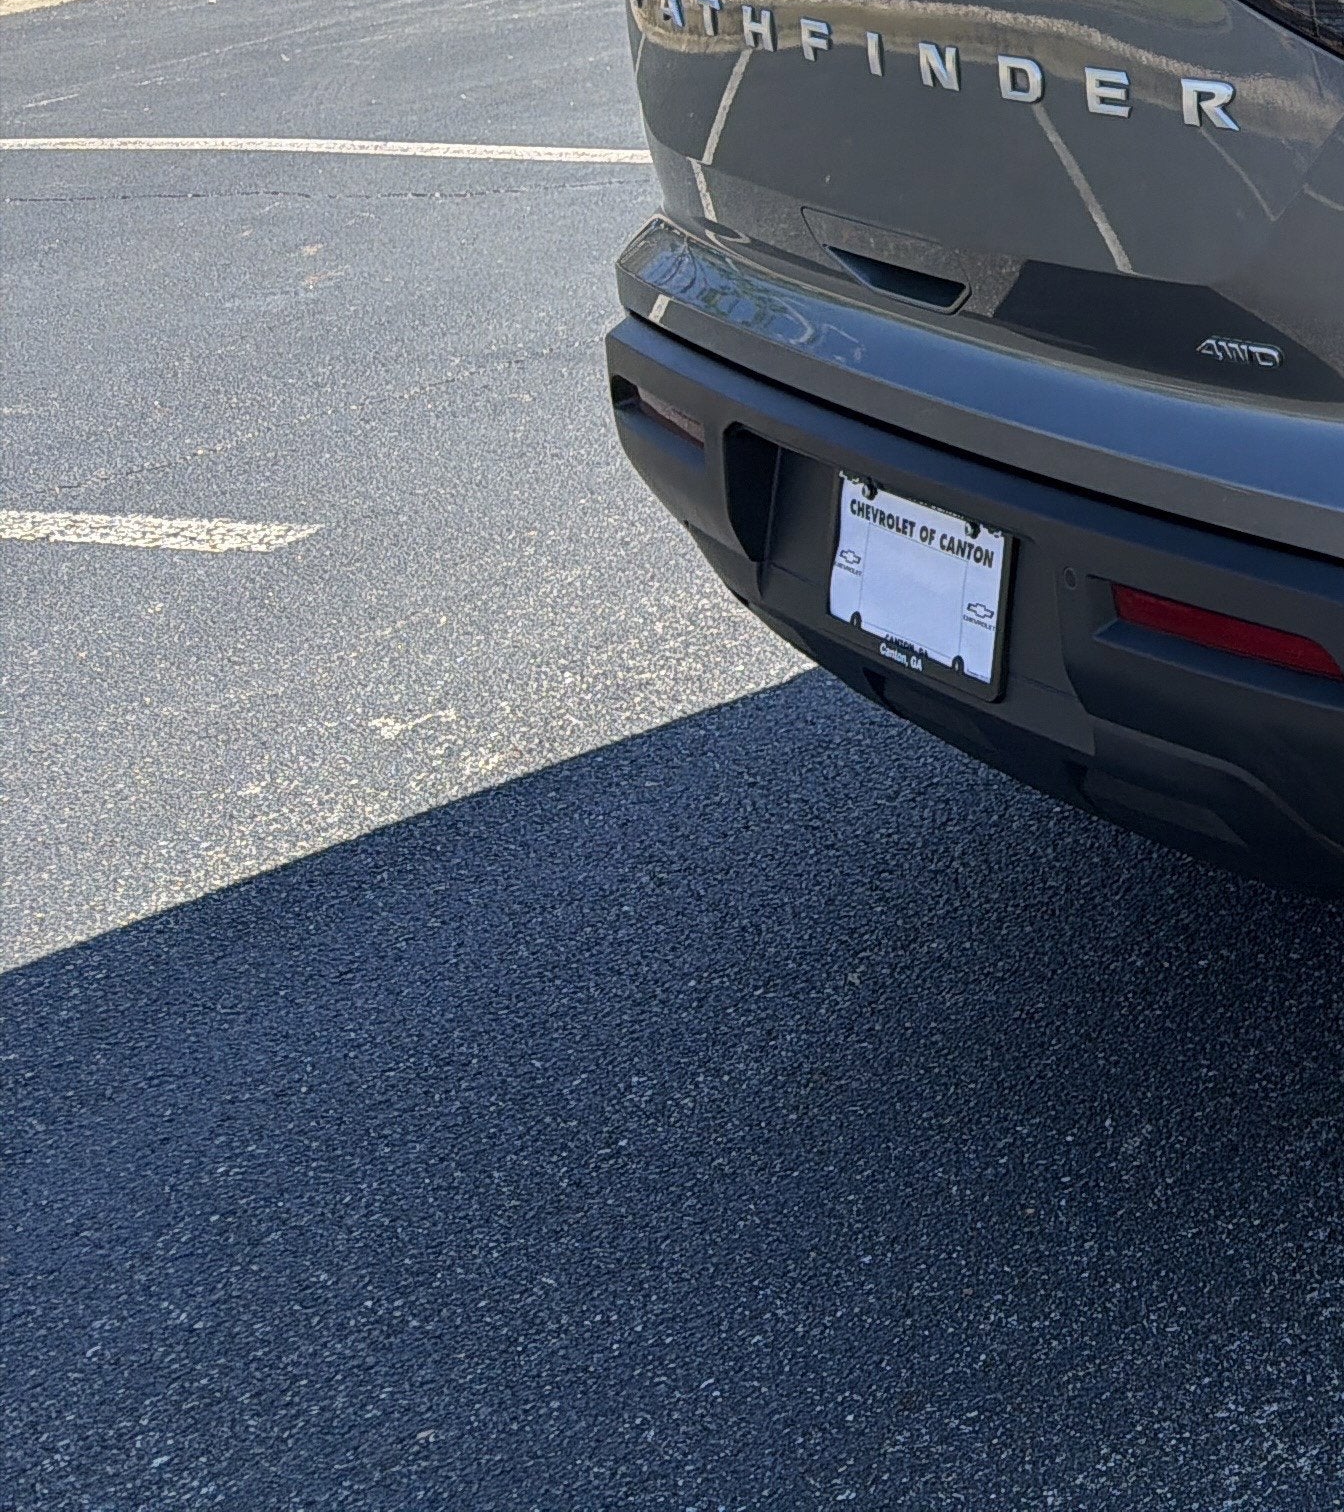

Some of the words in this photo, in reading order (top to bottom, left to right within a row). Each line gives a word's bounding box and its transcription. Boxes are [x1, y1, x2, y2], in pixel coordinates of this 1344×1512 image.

[1196, 335, 1283, 366] AWD
[850, 498, 916, 538] CHEVROLET
[919, 525, 936, 545] OF
[939, 533, 995, 569] CANTON
[879, 642, 909, 667] Canton,
[910, 655, 923, 672] GA
